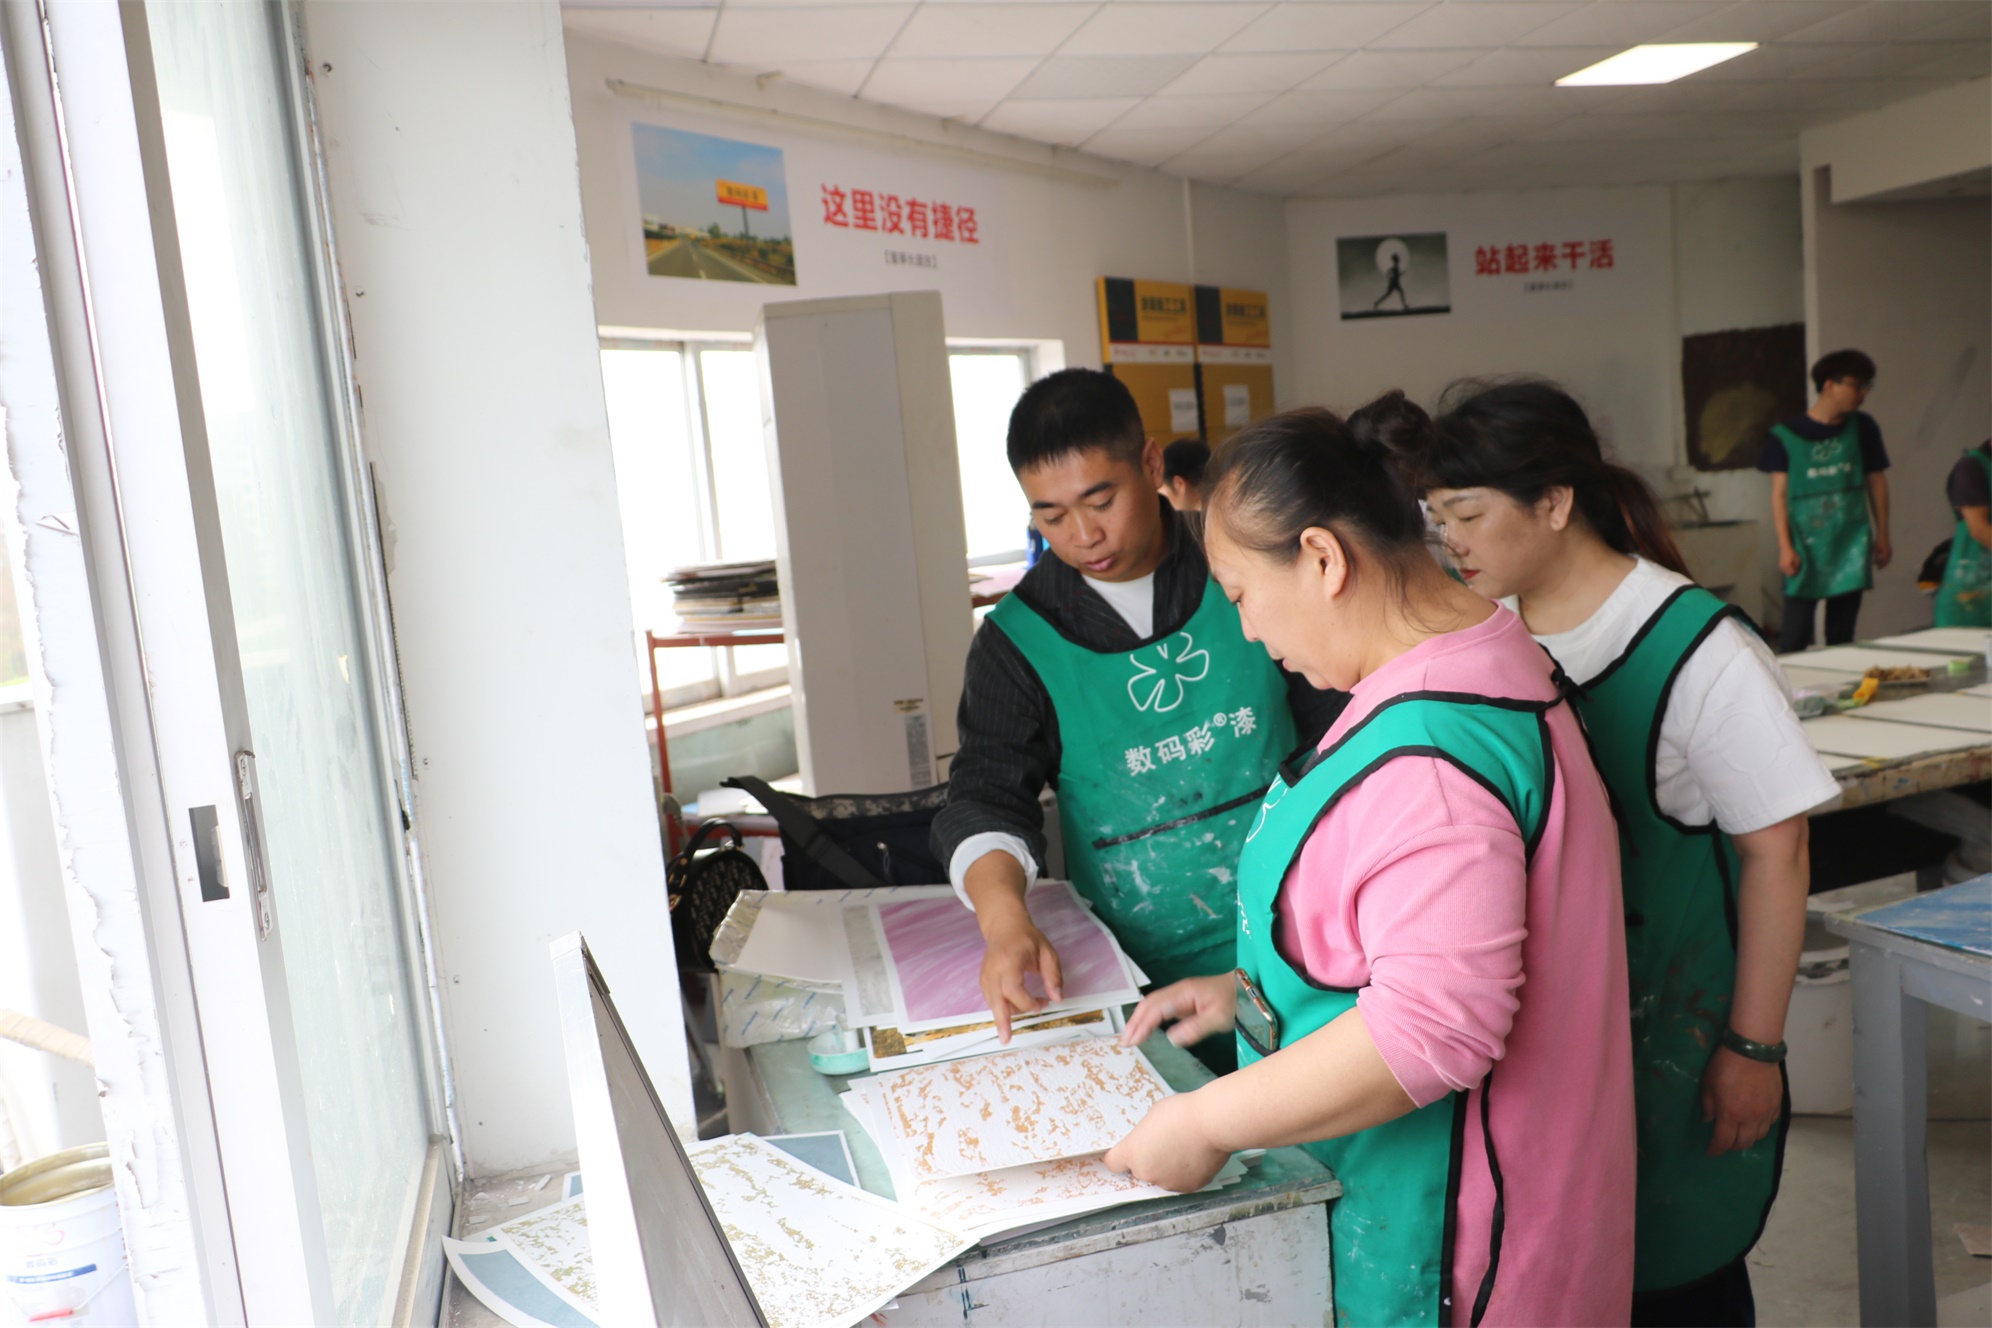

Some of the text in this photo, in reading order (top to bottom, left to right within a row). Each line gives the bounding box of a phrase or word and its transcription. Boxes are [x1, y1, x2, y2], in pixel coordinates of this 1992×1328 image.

[821, 183, 980, 245] 这里没有捷径
[1475, 239, 1614, 276] 站起来干活
